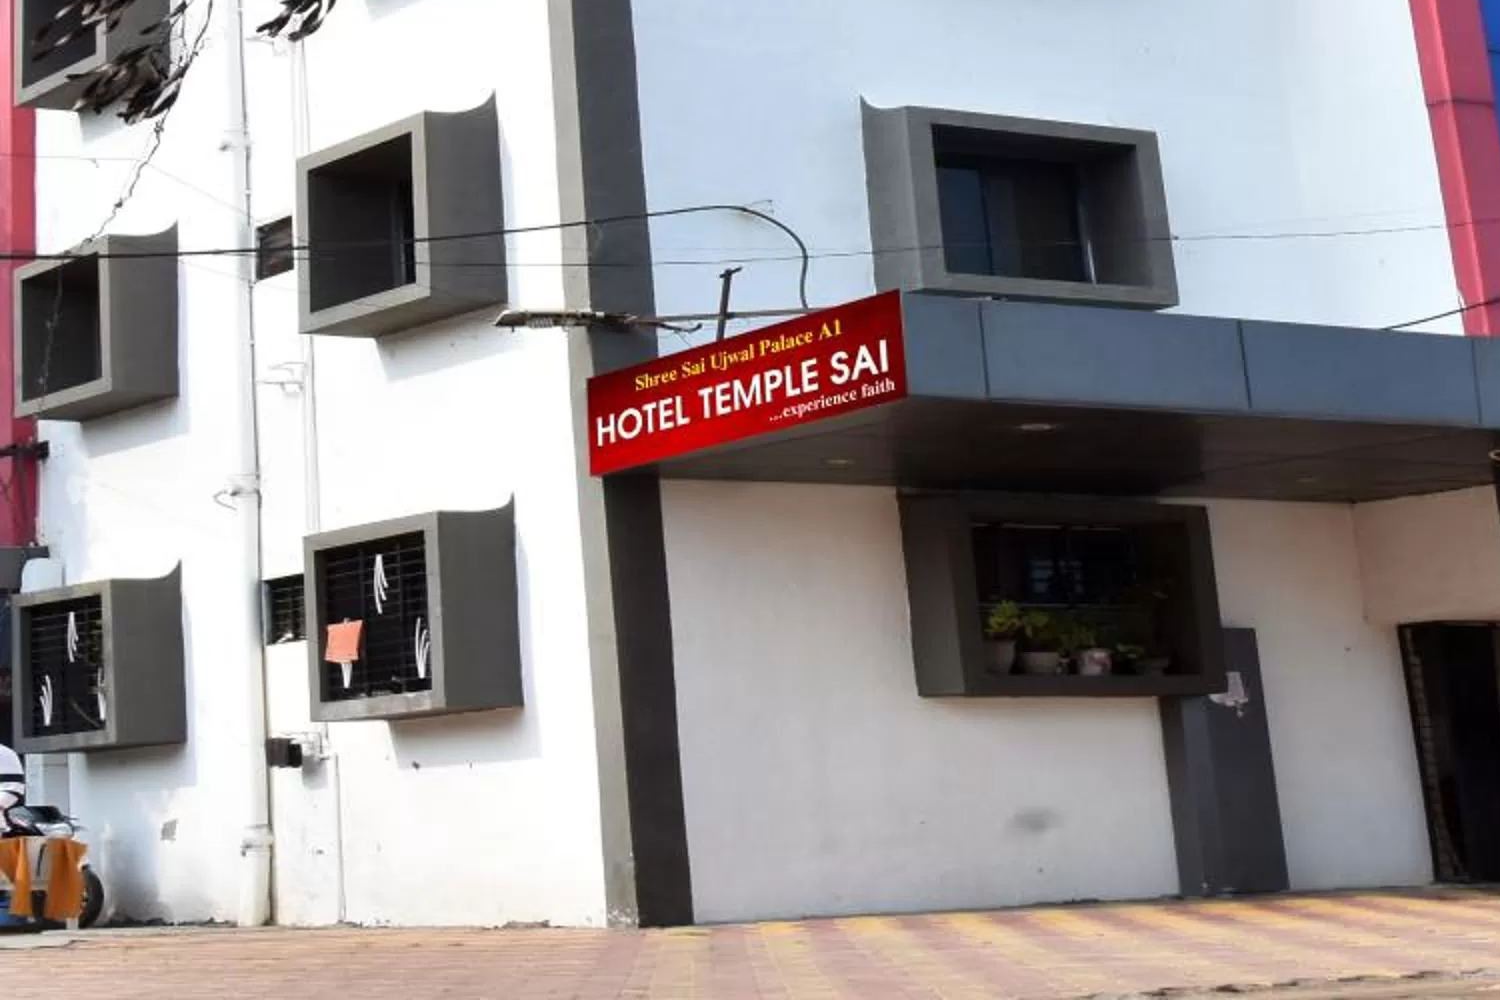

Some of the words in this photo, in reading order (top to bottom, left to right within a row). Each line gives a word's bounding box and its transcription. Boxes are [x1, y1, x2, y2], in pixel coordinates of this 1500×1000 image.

[635, 371, 678, 391] Shree
[681, 360, 706, 380] Sai
[710, 344, 755, 371] Ujwal
[759, 331, 813, 357] Palace
[861, 379, 896, 399] faith
[596, 396, 691, 447] HOTEL
[698, 358, 819, 419] TEMPLE
[830, 339, 890, 385] SAI
